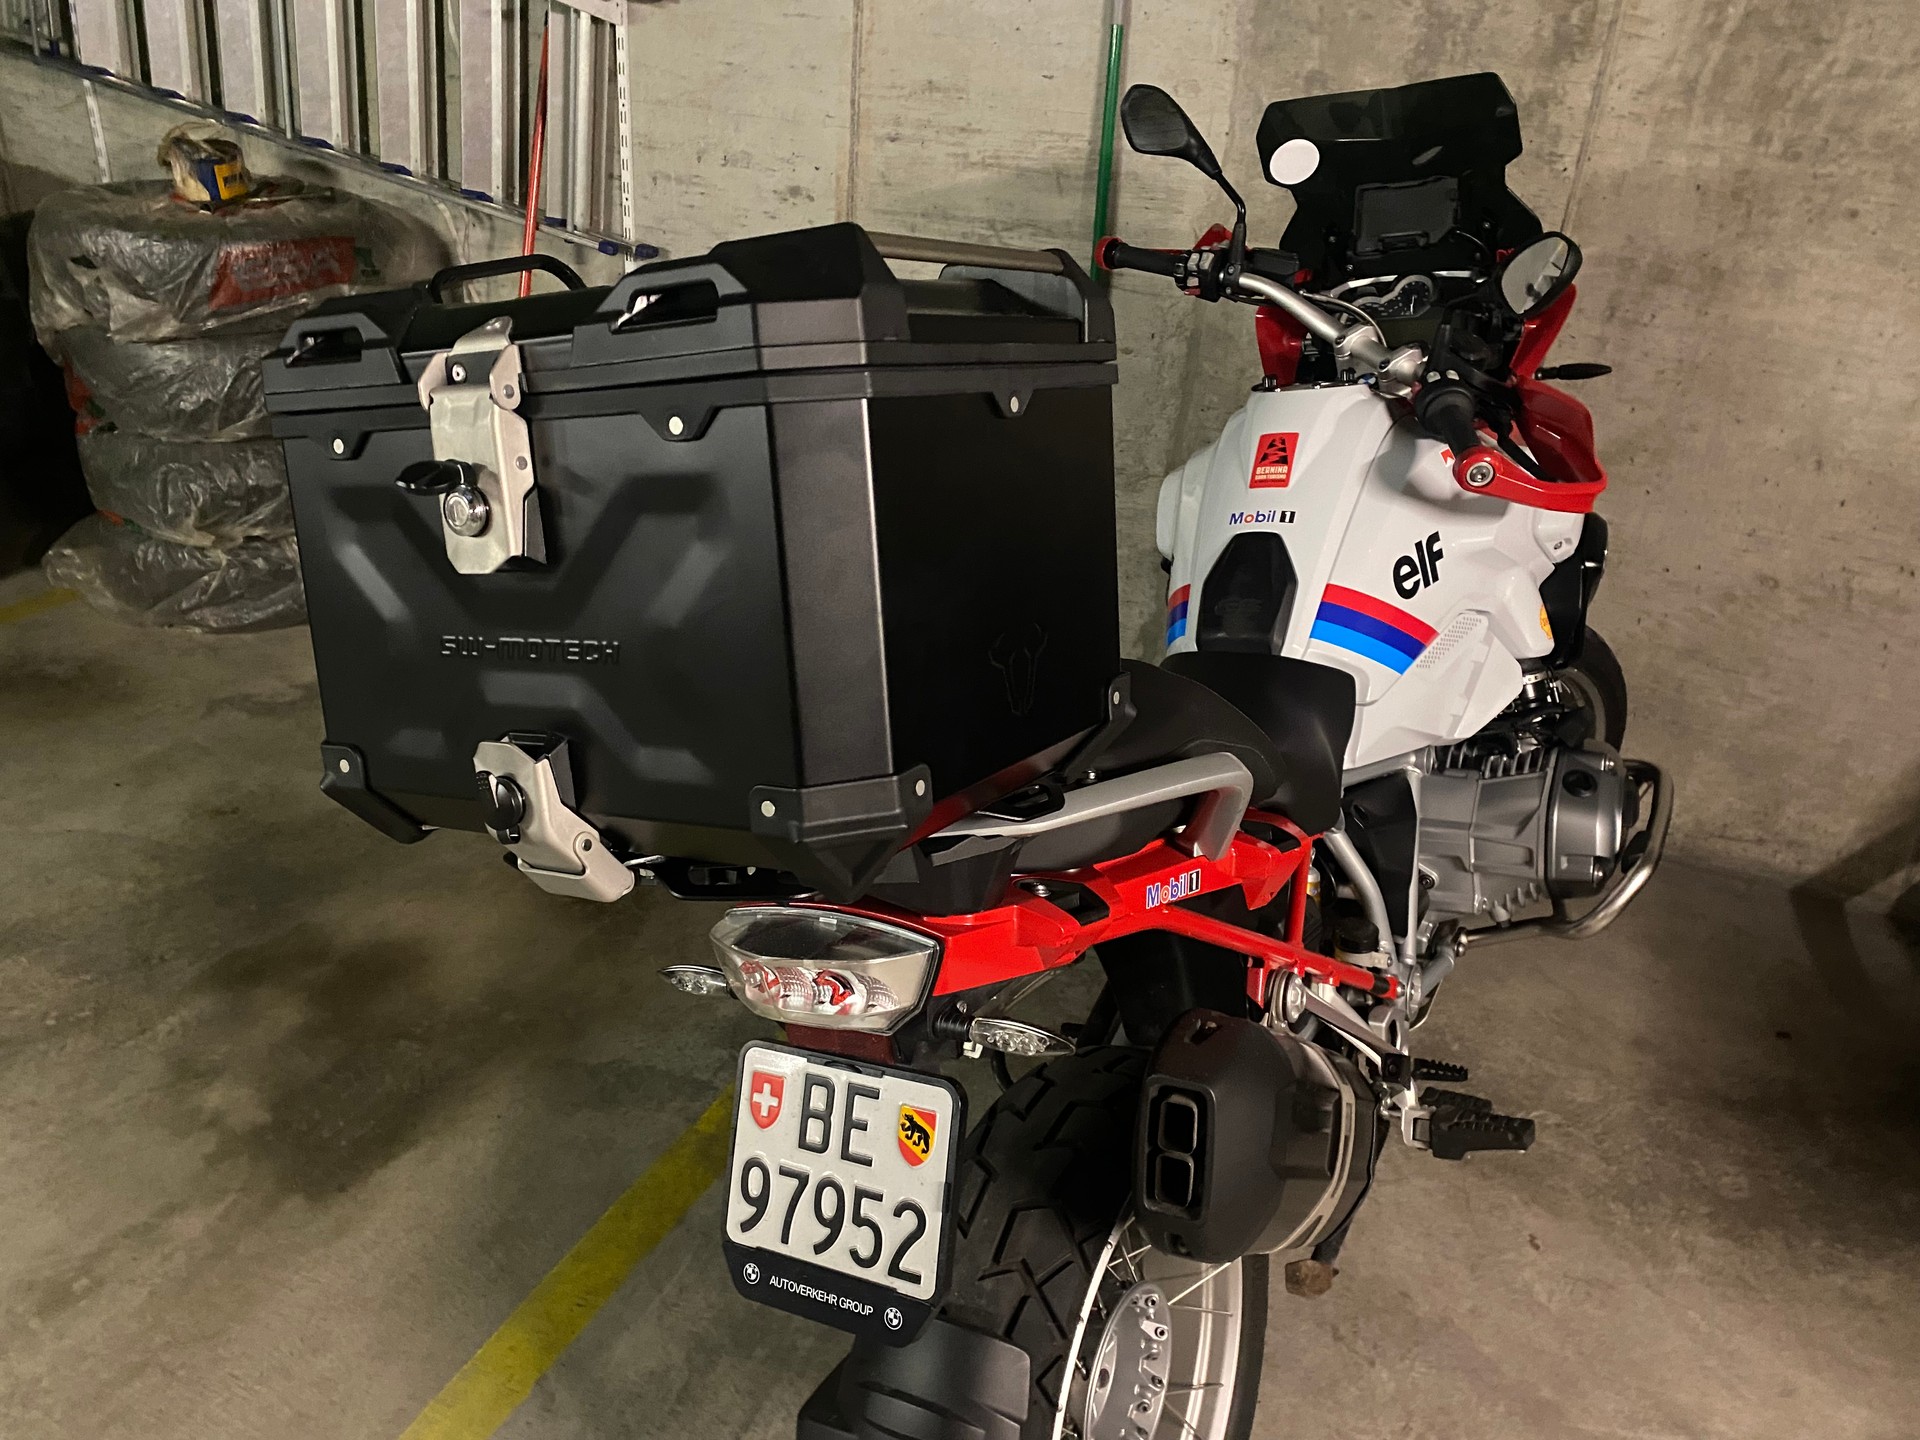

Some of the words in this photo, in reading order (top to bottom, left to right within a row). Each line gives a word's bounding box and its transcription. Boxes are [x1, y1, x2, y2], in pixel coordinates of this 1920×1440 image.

[1256, 466, 1288, 474] BERNINA
[1229, 510, 1276, 525] Mobil
[1393, 530, 1444, 599] elf
[440, 635, 620, 665] SW-MOTECH
[1146, 873, 1187, 909] Mobil
[798, 1073, 880, 1167] BE
[740, 1157, 926, 1285] 97952
[769, 1275, 837, 1306] AUTOVERKEHR
[839, 1297, 874, 1316] GROUP
